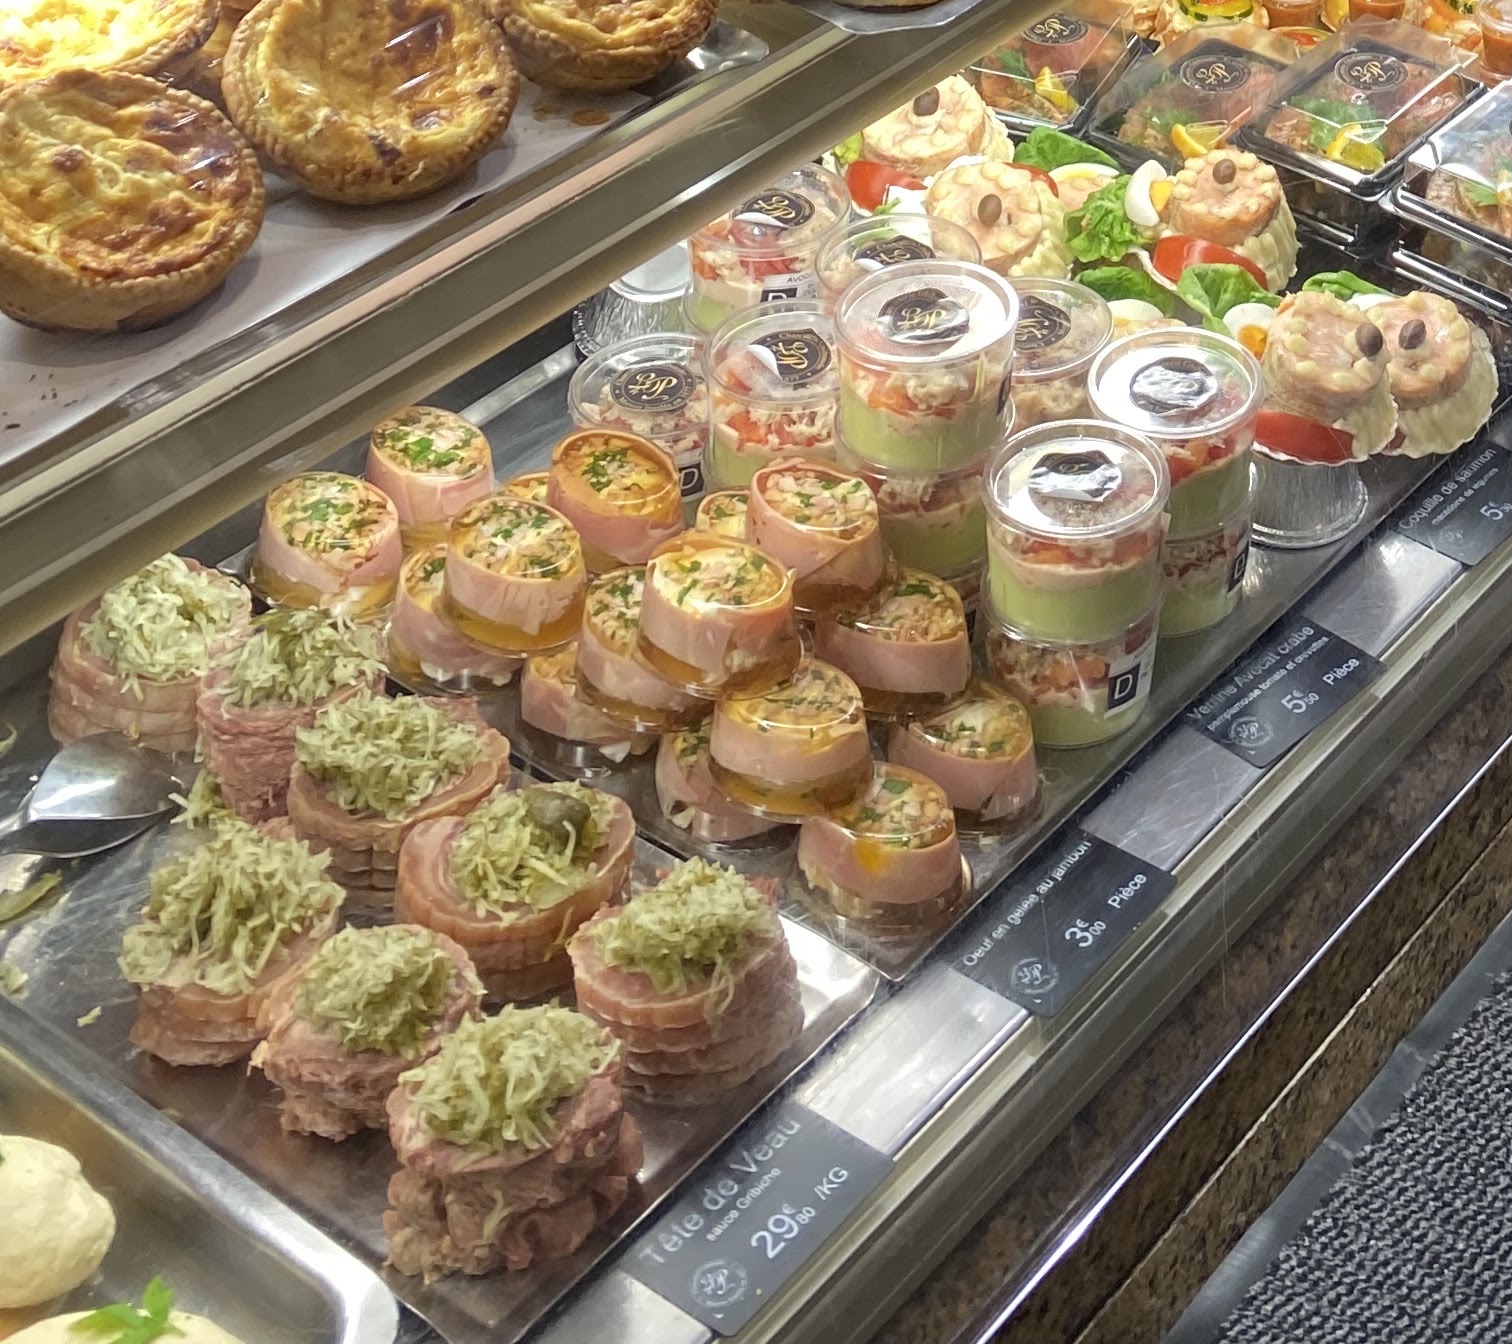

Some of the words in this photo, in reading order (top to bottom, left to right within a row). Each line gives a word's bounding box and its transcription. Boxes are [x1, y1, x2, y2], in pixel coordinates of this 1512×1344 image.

[1113, 673, 1134, 700] D
[1322, 657, 1361, 686] Pièce
[991, 922, 1012, 940] en
[1035, 876, 1056, 896] au
[1051, 840, 1093, 882] jambon
[1107, 872, 1148, 910] Pièce
[637, 1212, 705, 1265] Tête
[702, 1178, 739, 1212] de
[729, 1117, 802, 1175] Veau
[706, 1208, 740, 1244] sauce
[735, 1167, 782, 1210] Gribiche
